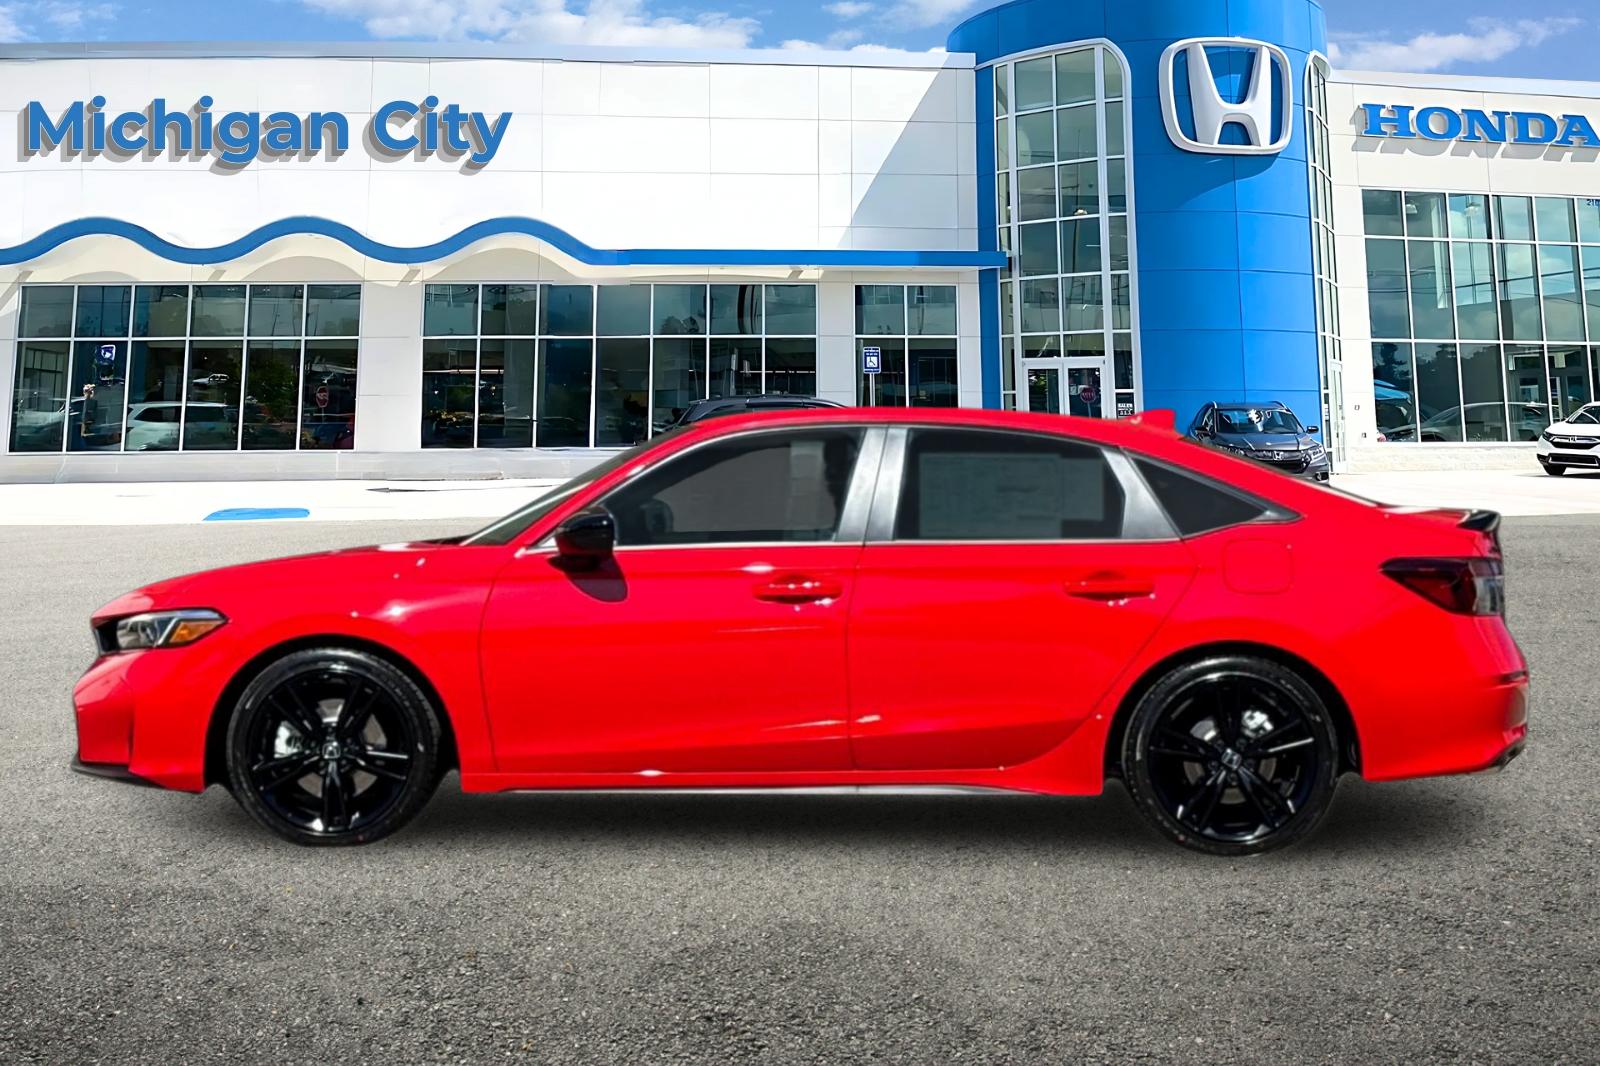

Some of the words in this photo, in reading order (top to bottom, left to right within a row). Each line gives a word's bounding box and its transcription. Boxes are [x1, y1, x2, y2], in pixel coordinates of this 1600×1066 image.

[26, 95, 349, 164] Michigan
[371, 95, 514, 164] City
[1361, 103, 1600, 147] HONDA
